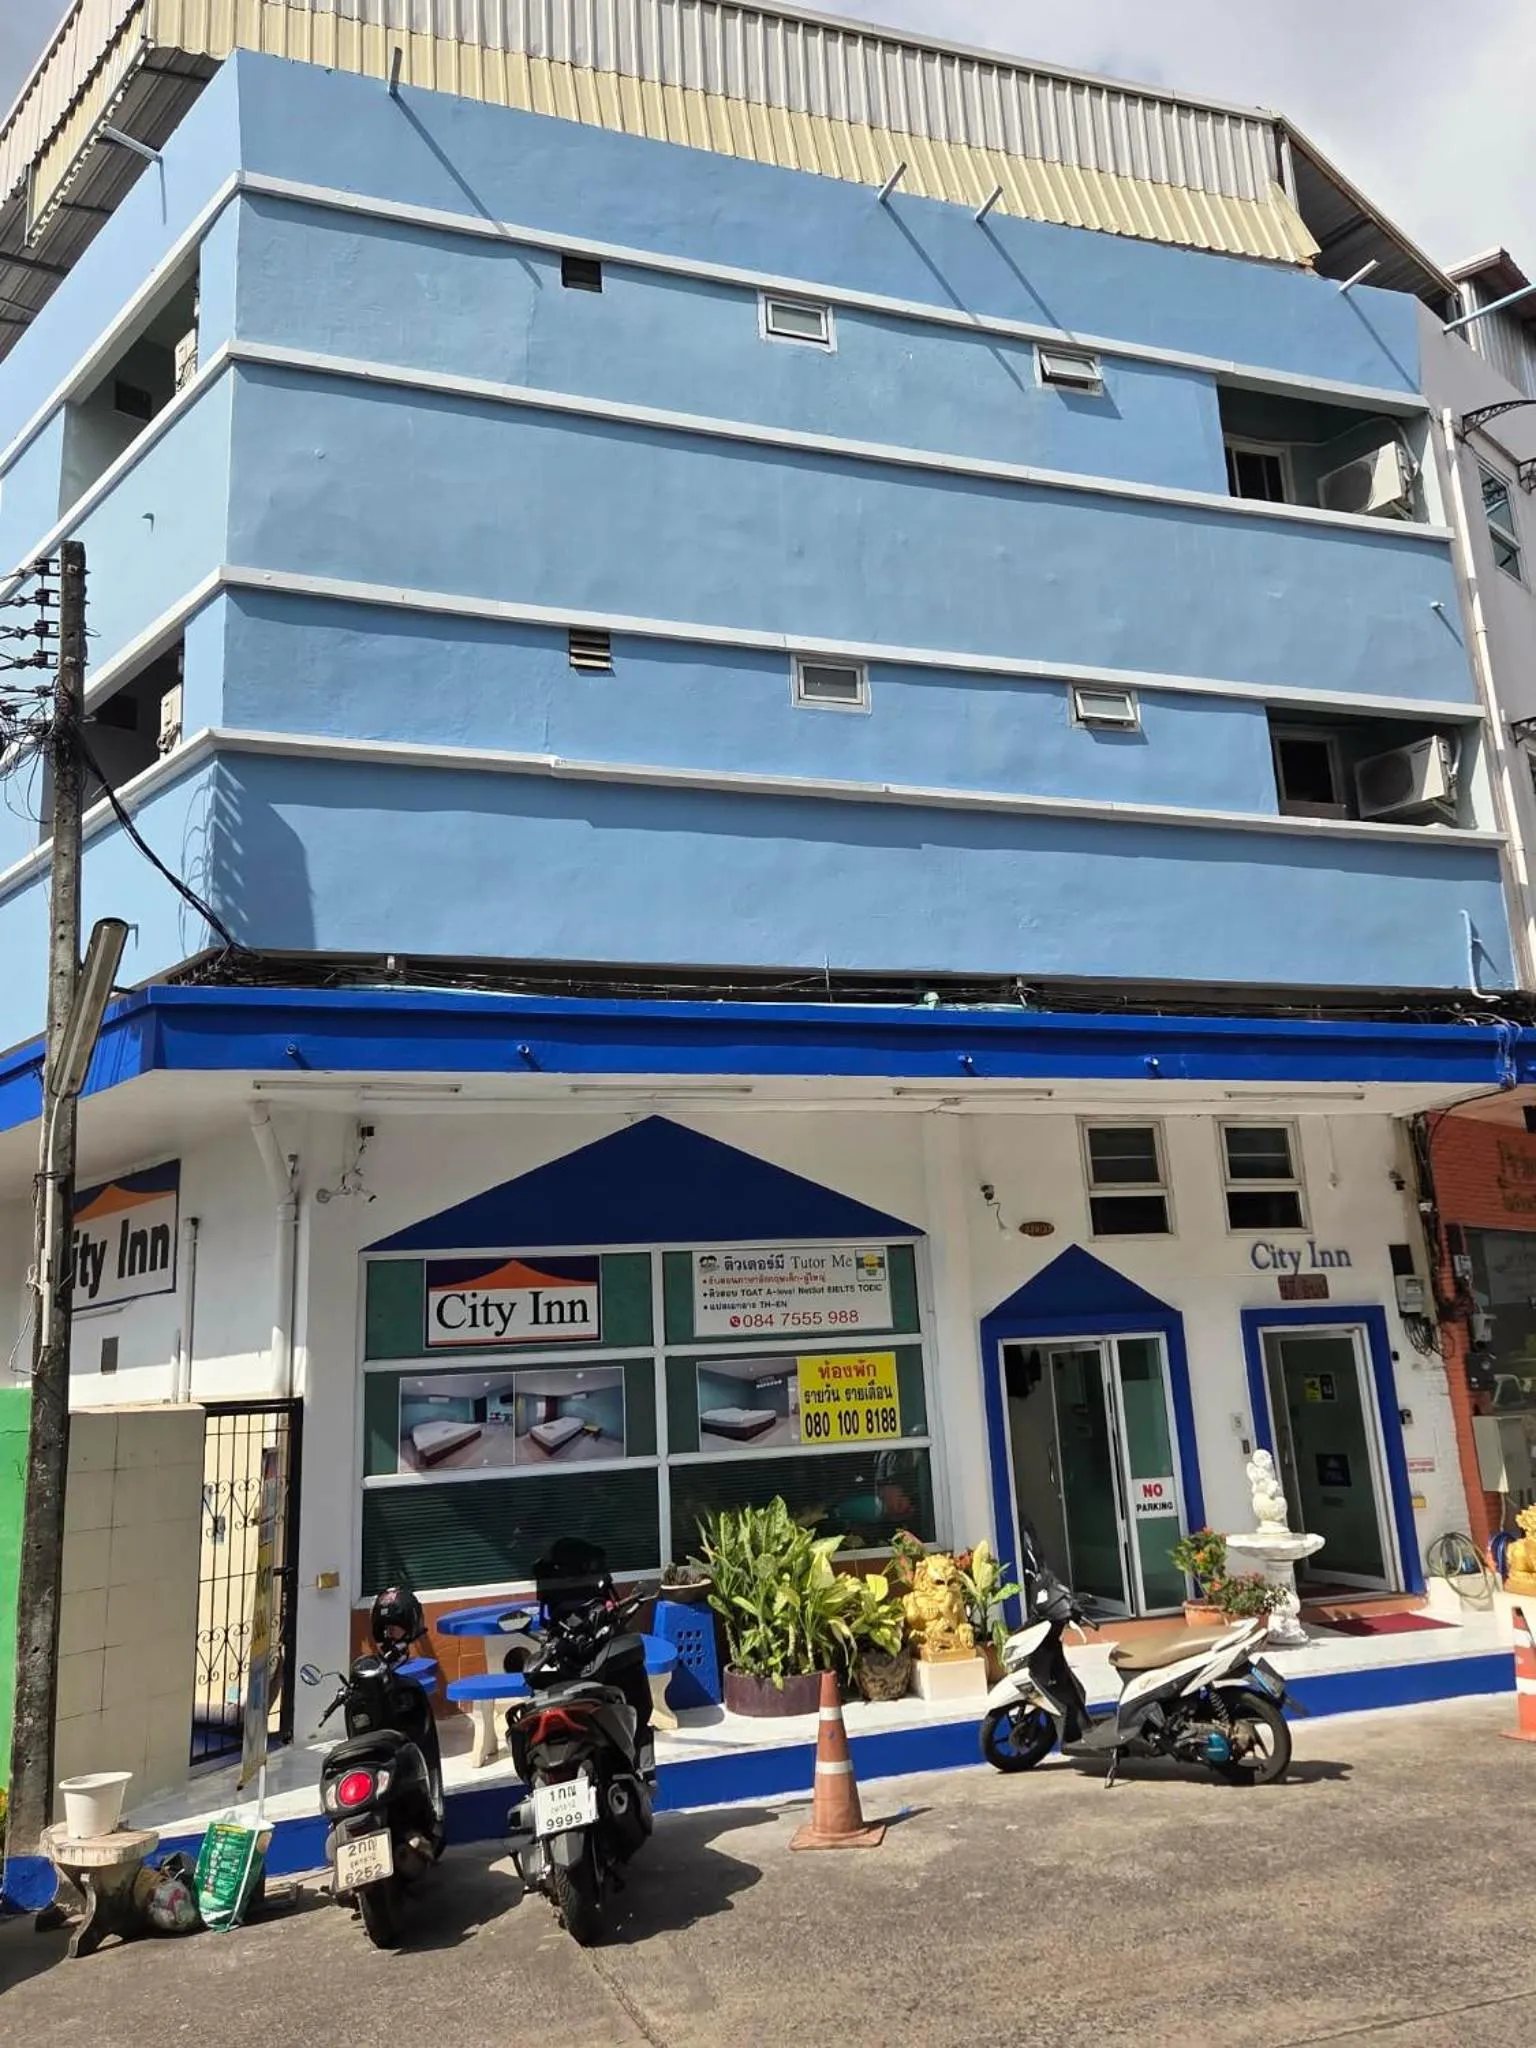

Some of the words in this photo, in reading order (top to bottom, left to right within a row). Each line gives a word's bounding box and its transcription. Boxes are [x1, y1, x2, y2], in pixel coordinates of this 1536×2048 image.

[72, 1229, 107, 1300] ity
[118, 1219, 170, 1279] Inn
[791, 1256, 827, 1270] Tutor
[832, 1254, 853, 1268] Me
[1250, 1241, 1301, 1275] City
[1307, 1240, 1352, 1268] Inn
[436, 1291, 517, 1337] City
[529, 1291, 590, 1325] Inn
[743, 1313, 775, 1328] 084
[781, 1312, 823, 1326] 7555
[828, 1310, 859, 1324] 988
[804, 1384, 840, 1404] รายวัน
[845, 1379, 893, 1402] รายเดือน
[805, 1411, 830, 1438] 080
[838, 1409, 859, 1436] 100
[866, 1407, 897, 1433] 8188
[1142, 1483, 1163, 1498] NO
[1136, 1501, 1174, 1512] PARKING
[546, 1812, 583, 1830] 9999
[345, 1863, 383, 1885] 6252
